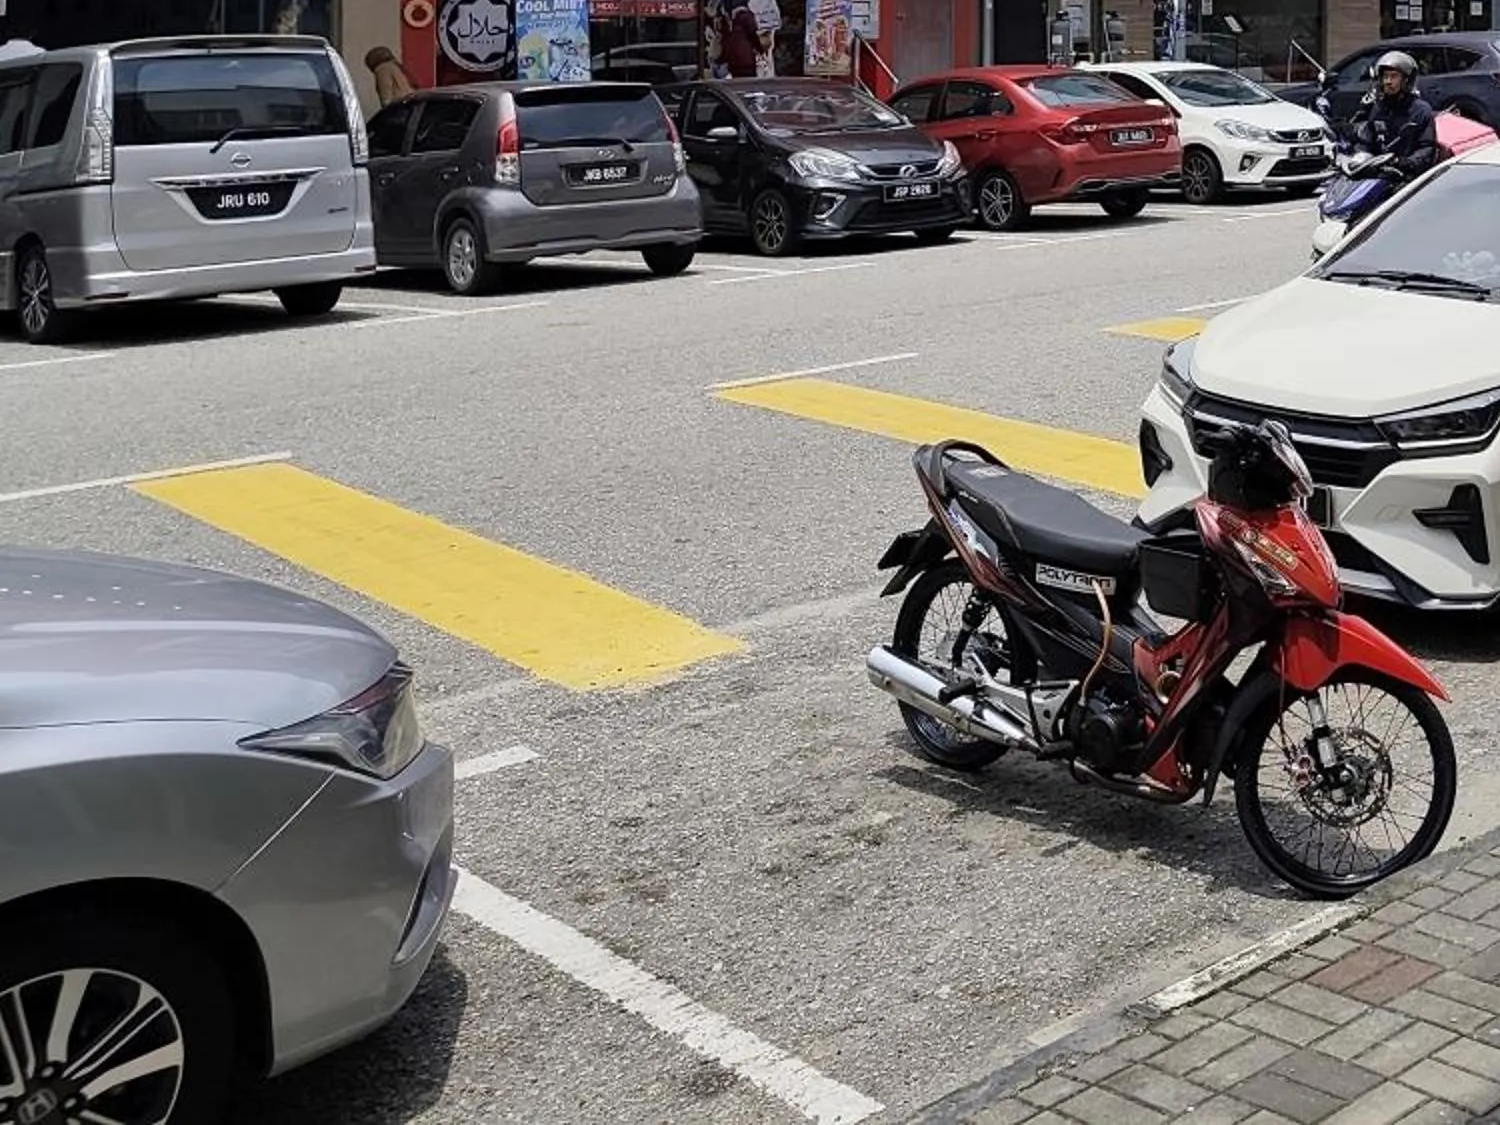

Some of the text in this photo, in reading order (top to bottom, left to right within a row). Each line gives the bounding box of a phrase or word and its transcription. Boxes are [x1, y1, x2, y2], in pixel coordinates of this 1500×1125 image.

[516, 0, 550, 13] COOL
[217, 192, 270, 209] JRU 610
